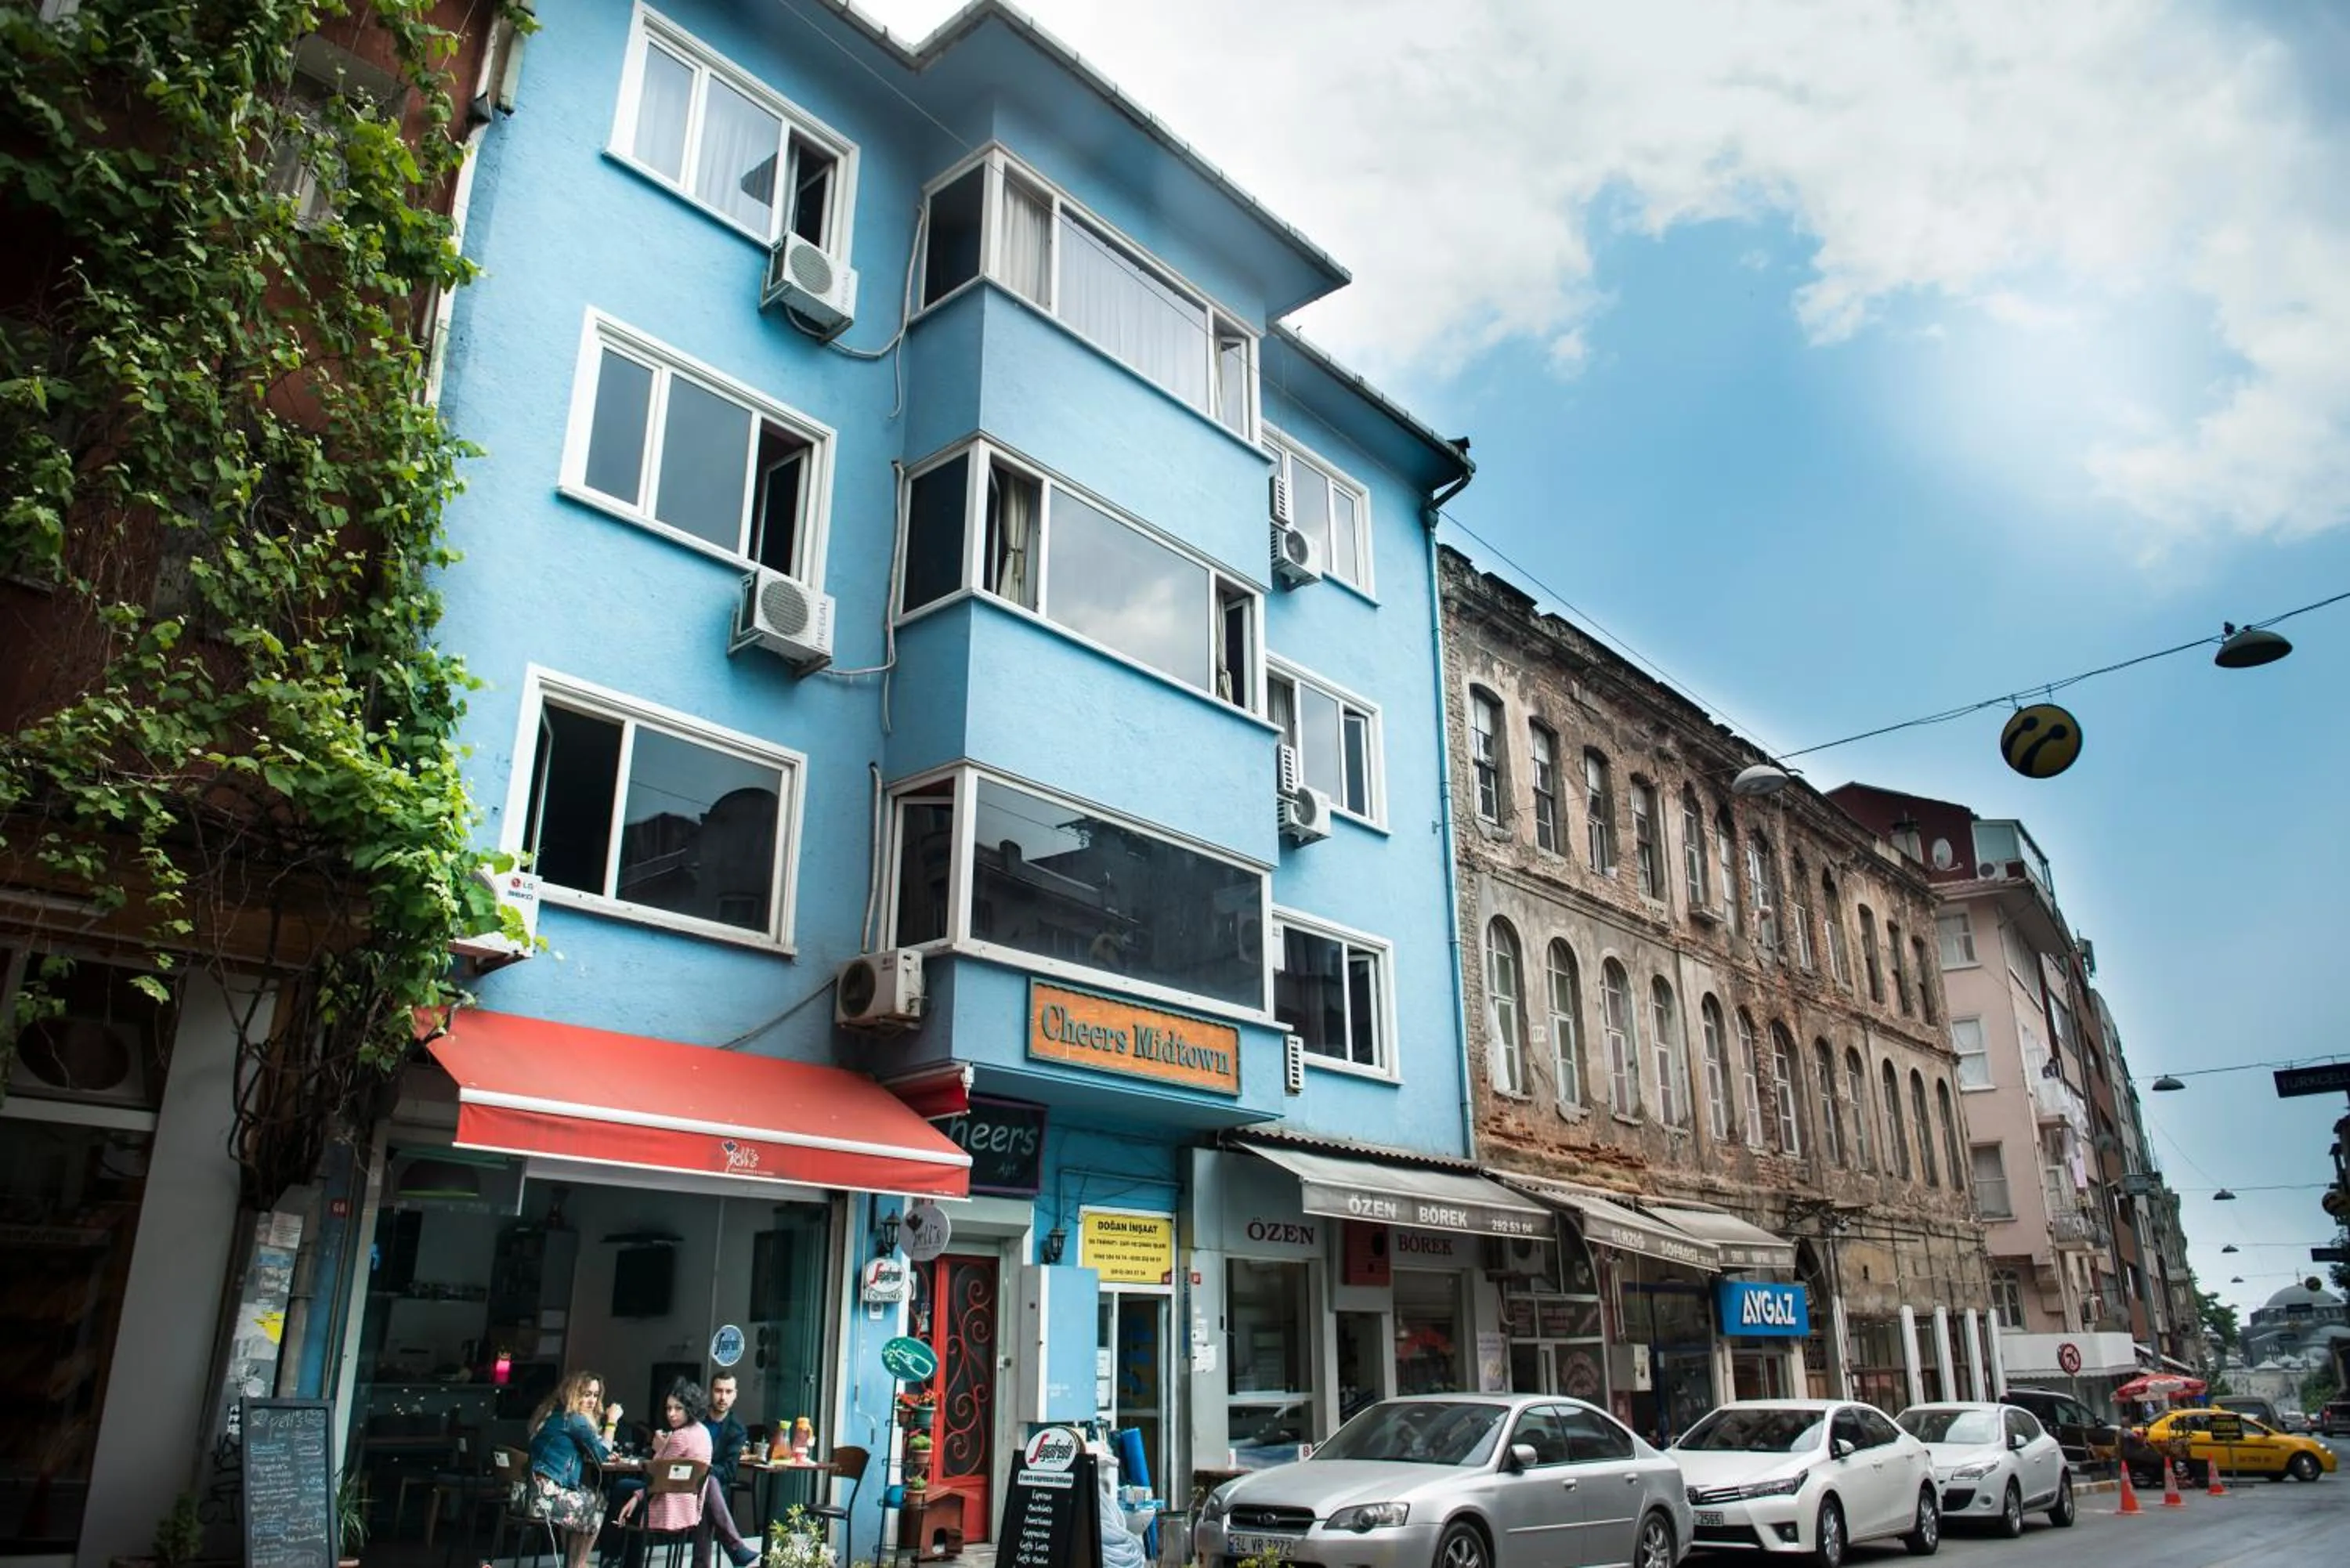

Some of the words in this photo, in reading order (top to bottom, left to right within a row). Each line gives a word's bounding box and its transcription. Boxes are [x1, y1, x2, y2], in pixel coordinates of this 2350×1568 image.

[1041, 1003, 1127, 1053] Cheers
[1133, 1024, 1231, 1076] Midtown
[949, 1116, 1039, 1156] heers
[1097, 1220, 1126, 1231] DOĞAN
[1129, 1221, 1159, 1234] İNŞAAT
[1348, 1194, 1397, 1219] ÖZEN
[1419, 1205, 1467, 1228] BÖREK
[1247, 1217, 1315, 1245] ÖZEN
[1398, 1231, 1453, 1255] BÖREK
[1742, 1290, 1796, 1325] AYGAZ
